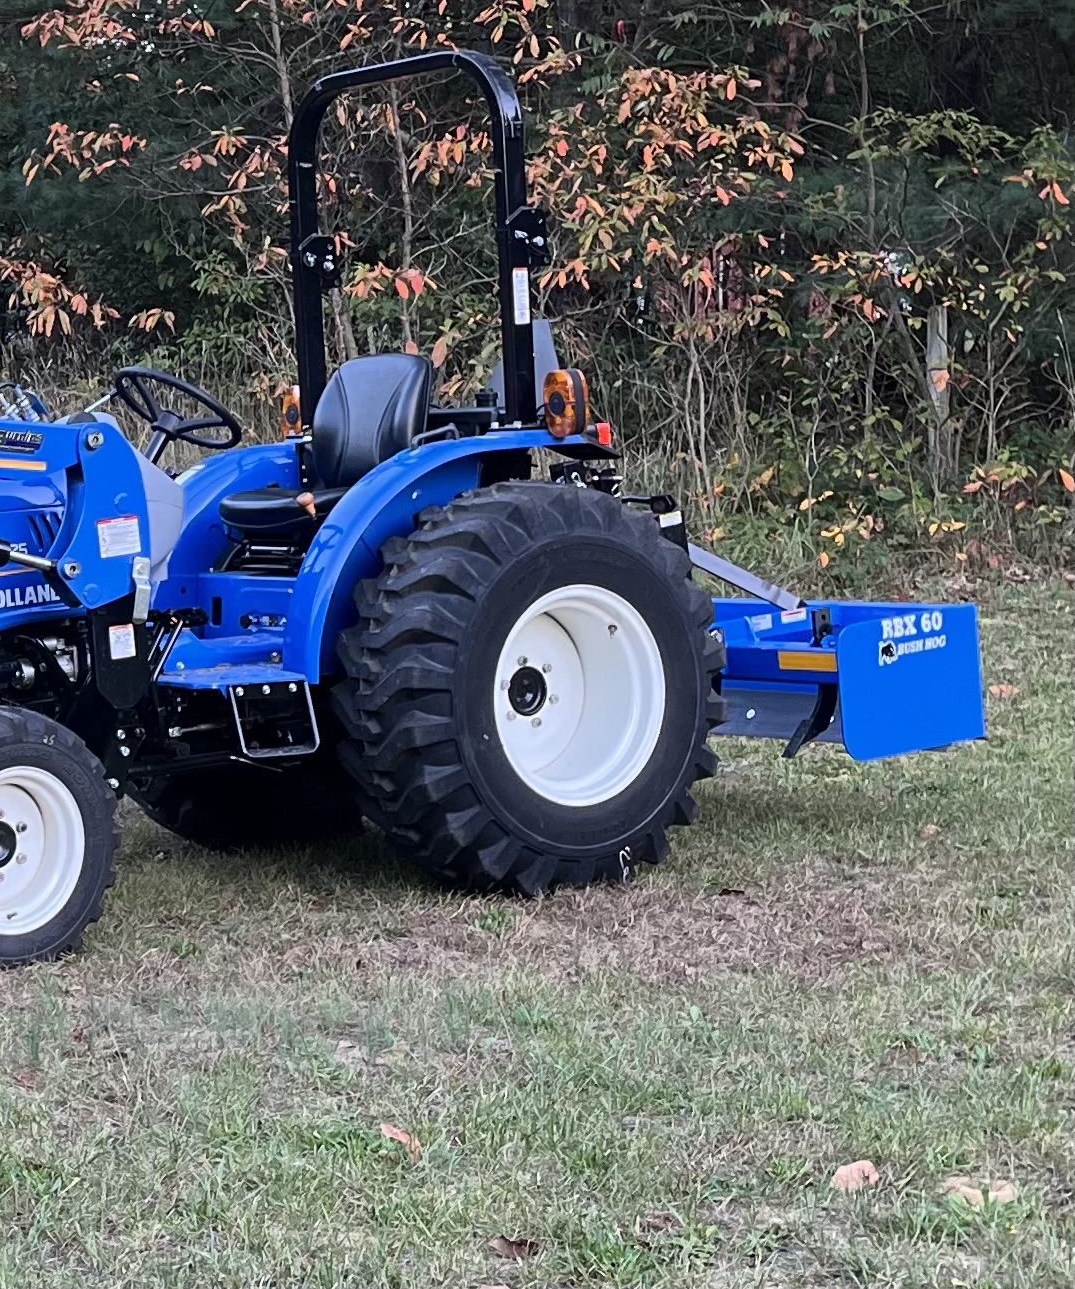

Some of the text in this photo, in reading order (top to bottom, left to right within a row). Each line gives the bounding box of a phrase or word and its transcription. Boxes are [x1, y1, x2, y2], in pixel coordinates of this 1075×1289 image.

[881, 611, 943, 640] RBX 60
[897, 633, 947, 656] BUSH HOG
